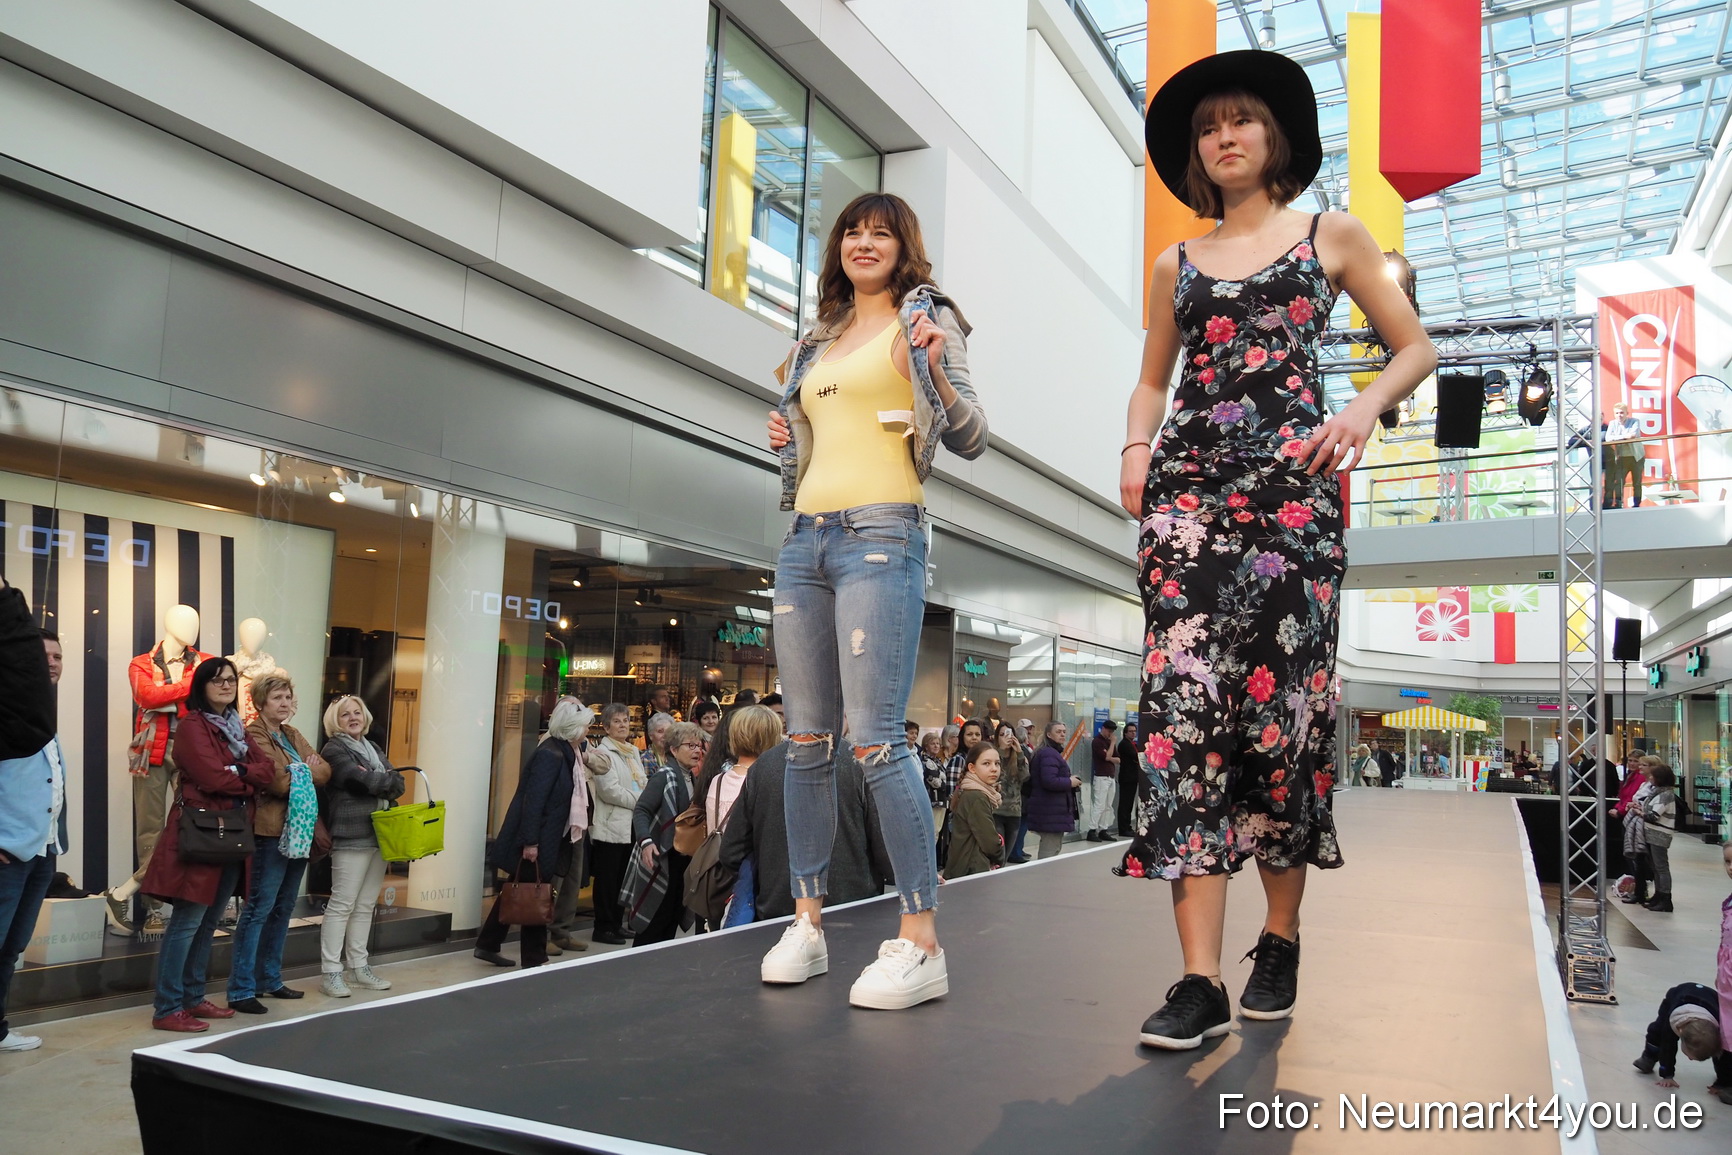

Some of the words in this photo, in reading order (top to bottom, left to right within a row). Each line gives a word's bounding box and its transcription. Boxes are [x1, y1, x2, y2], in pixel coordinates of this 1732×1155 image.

[1623, 313, 1667, 506] CINEPE
[420, 888, 456, 902] MONTI
[59, 932, 68, 943] &
[69, 930, 103, 943] MORE
